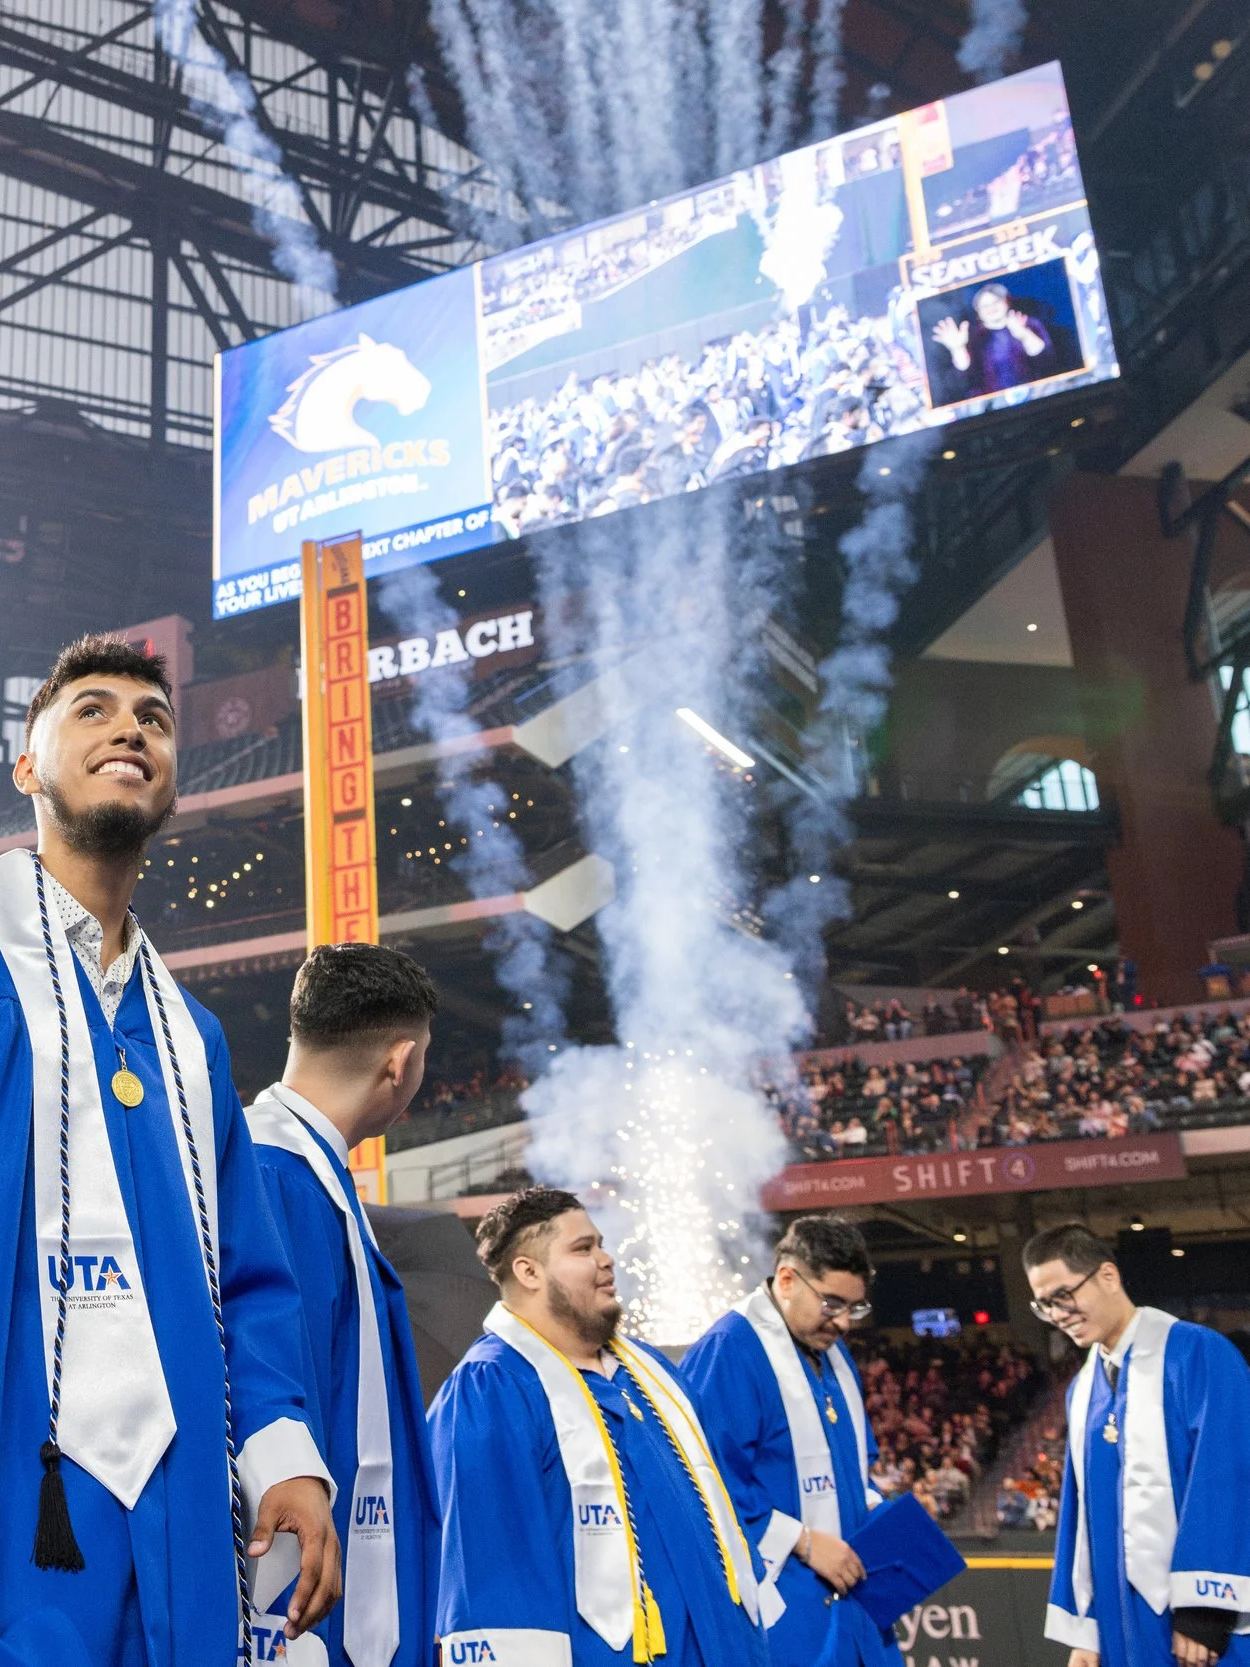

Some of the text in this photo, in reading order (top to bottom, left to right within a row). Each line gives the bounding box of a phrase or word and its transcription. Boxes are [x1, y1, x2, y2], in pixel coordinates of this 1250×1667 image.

[911, 225, 1059, 287] SEATGEEK
[248, 439, 451, 525] MAVERICKS
[272, 505, 300, 534] UT
[216, 508, 490, 601] AS YOU BEG EXT CHAPTER OF
[215, 589, 263, 616] YOUR
[366, 610, 535, 684] RBACH
[335, 599, 358, 806] BRING
[892, 1157, 1026, 1193] SHIFT 4
[47, 1255, 131, 1291] UTA
[77, 1302, 116, 1310] ARLINGTON
[113, 1293, 134, 1301] TEXAS
[803, 1475, 835, 1493] UTA
[356, 1496, 390, 1526] UTA
[578, 1504, 622, 1525] UTA
[1196, 1579, 1237, 1601] UTA
[237, 1626, 287, 1662] TA
[893, 1604, 982, 1652] yen
[450, 1640, 496, 1665] UTA
